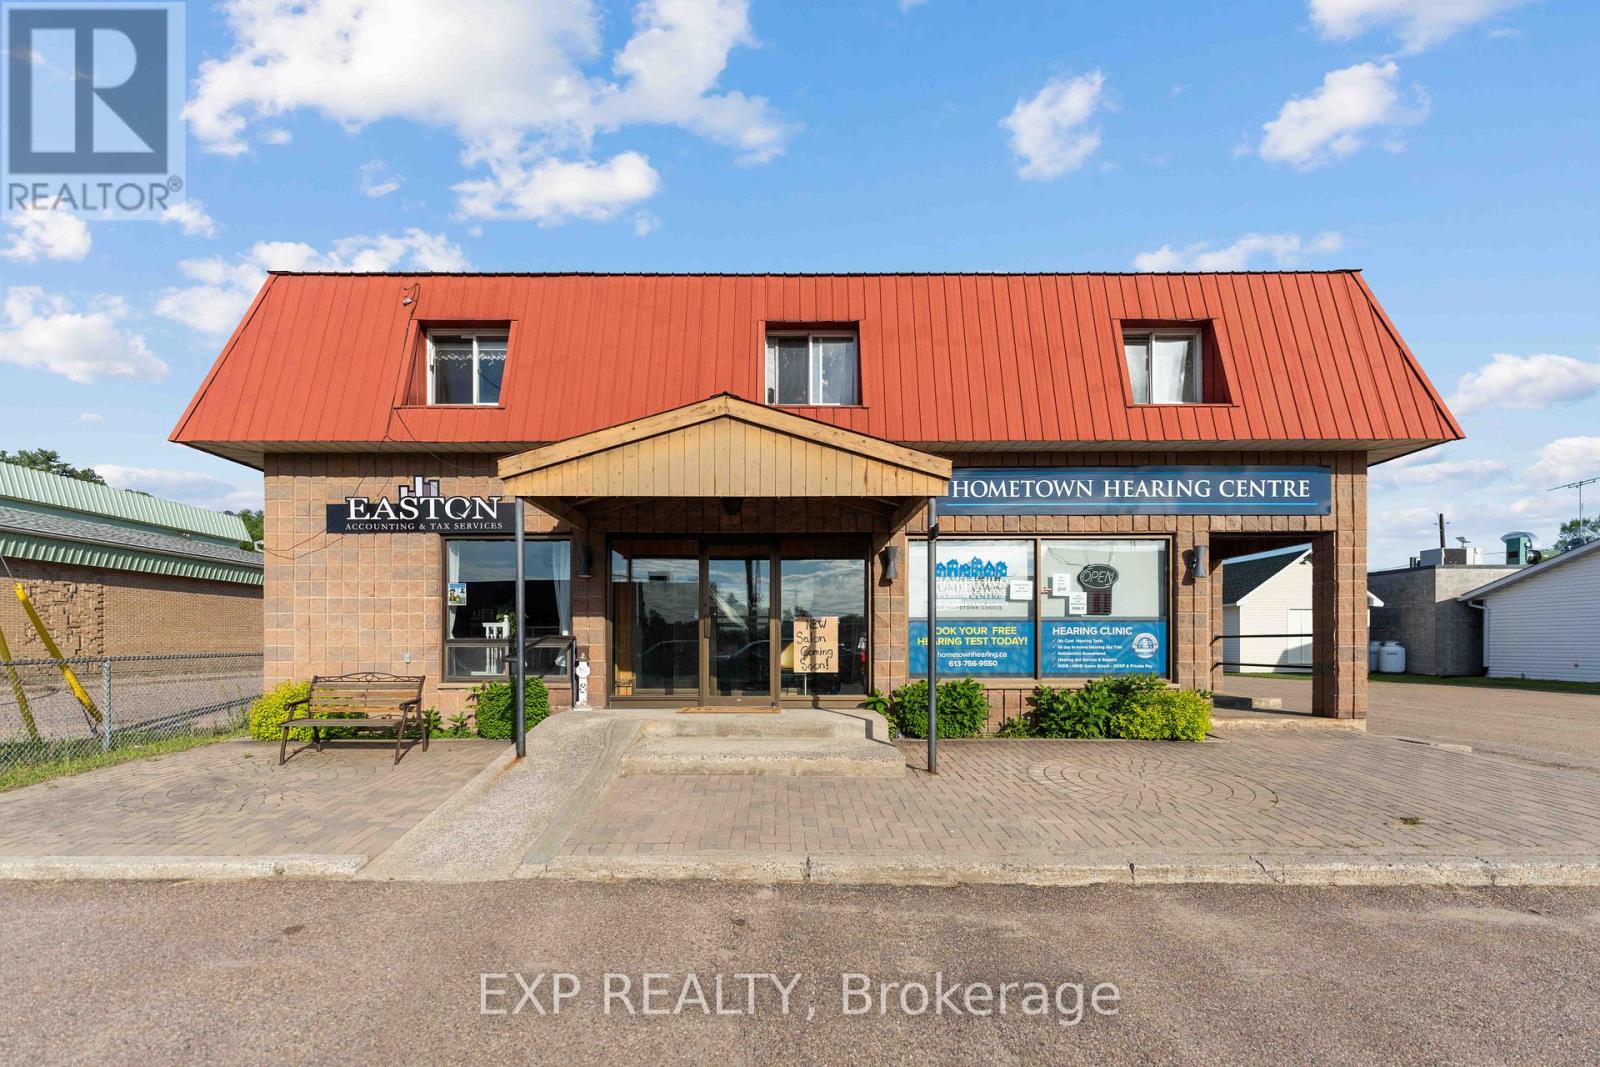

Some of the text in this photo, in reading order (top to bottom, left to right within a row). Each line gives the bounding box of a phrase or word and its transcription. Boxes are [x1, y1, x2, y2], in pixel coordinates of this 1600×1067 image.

[952, 479, 1311, 498] HOMETOWN HEARING CENTRE
[346, 496, 501, 521] EASTON
[345, 523, 415, 531] ACCOUNTING
[454, 522, 503, 530] SERVICES
[1082, 570, 1115, 583] OPEN
[936, 627, 1017, 635] OOK YOUR FREE
[1053, 627, 1133, 635] HEARING CLINIC
[796, 631, 826, 644] Salon
[917, 637, 1028, 646] HERING TEST TODAY!
[800, 646, 833, 658] Coming
[800, 657, 829, 671] Soon!
